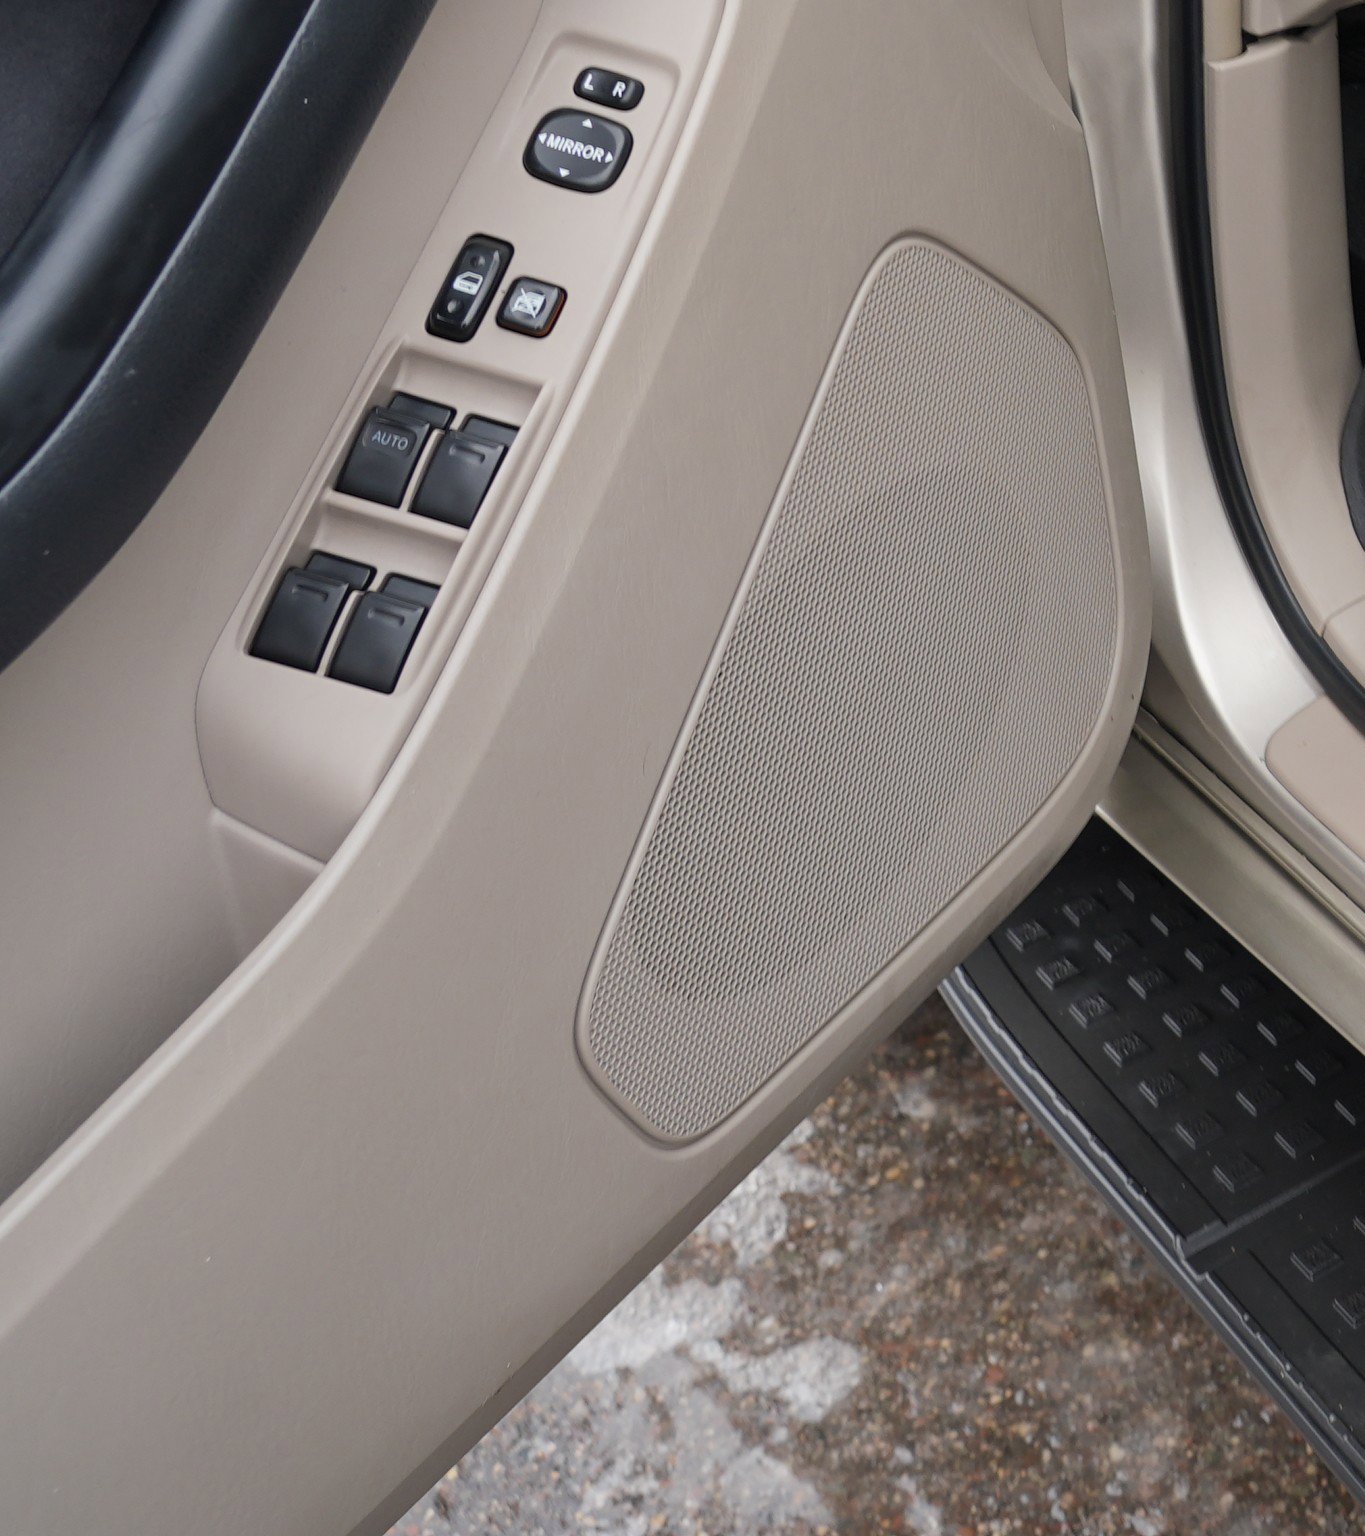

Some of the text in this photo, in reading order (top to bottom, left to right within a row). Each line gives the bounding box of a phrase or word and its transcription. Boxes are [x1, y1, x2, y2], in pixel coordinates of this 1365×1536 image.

[583, 73, 626, 98] L R
[546, 133, 605, 163] MIRROR
[371, 429, 409, 451] AUTO
